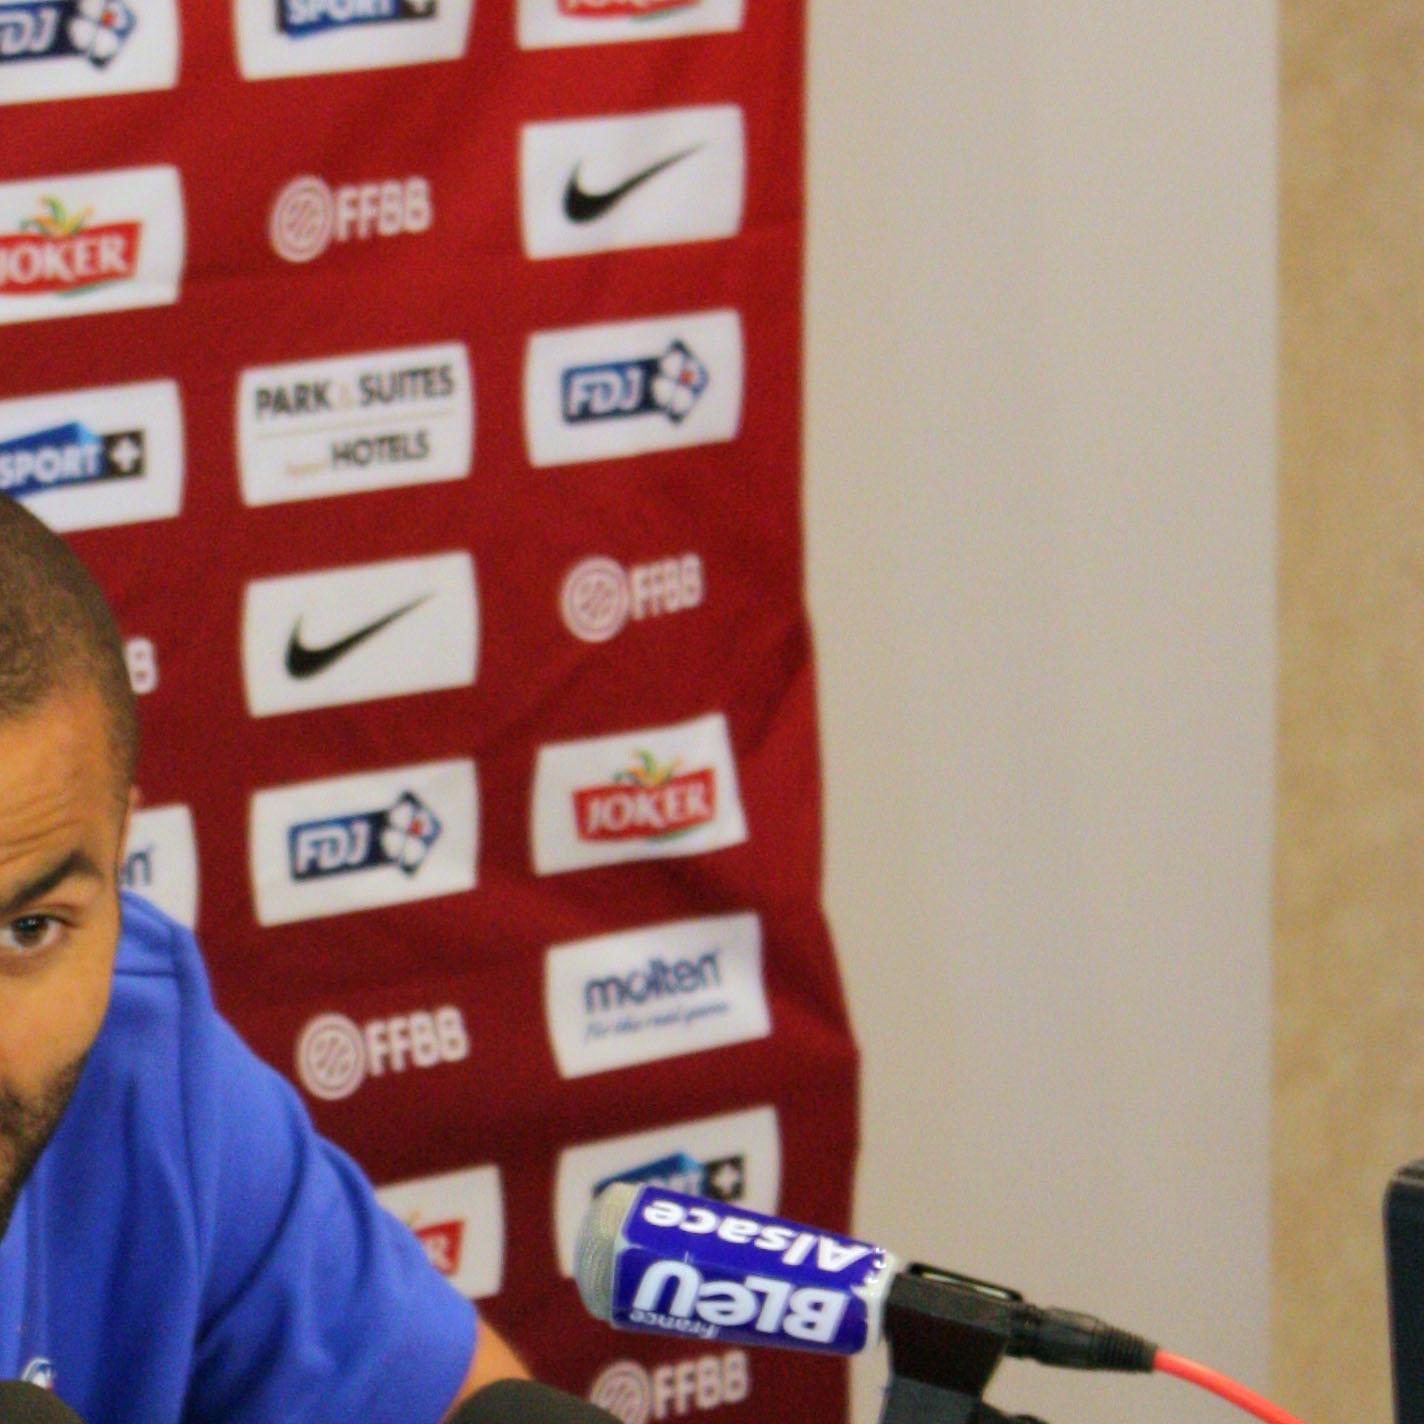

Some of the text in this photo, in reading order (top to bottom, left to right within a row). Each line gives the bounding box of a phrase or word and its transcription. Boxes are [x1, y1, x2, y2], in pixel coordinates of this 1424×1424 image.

[333, 177, 432, 243] FFBB
[255, 381, 331, 419] PARK
[359, 365, 454, 407] SUITES
[566, 368, 646, 418] FDJ
[331, 431, 429, 469] HOTELS
[632, 552, 704, 621] FFBB
[582, 778, 713, 835] JOKER
[297, 819, 373, 872] FDJ
[583, 950, 723, 1014] molten
[366, 1005, 468, 1076] FFBB
[643, 1198, 876, 1274] Alsace
[651, 1349, 751, 1421] FFBB
